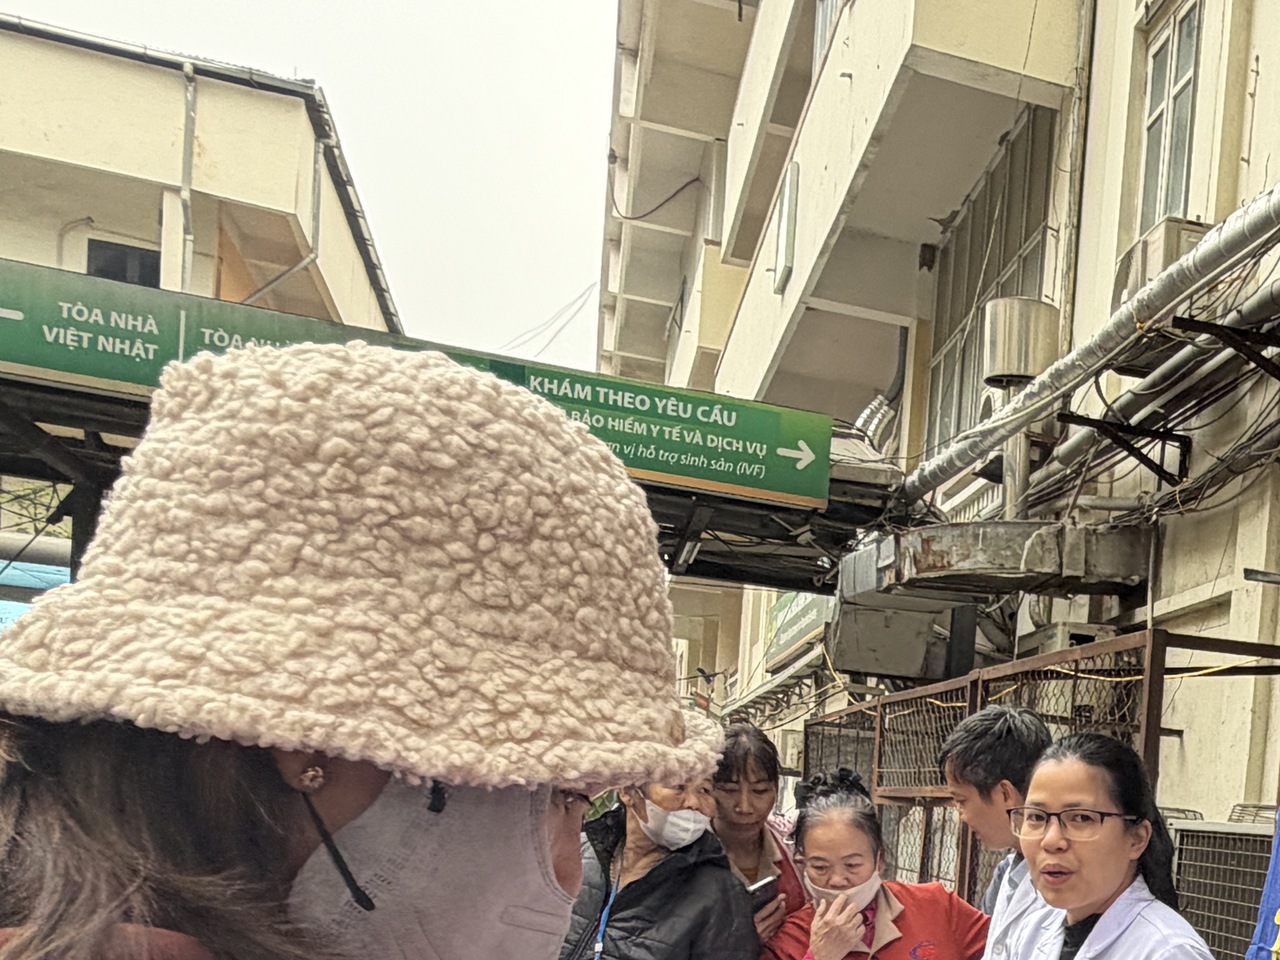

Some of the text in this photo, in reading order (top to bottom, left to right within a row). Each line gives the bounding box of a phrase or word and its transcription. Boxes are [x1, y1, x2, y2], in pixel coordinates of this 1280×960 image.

[58, 301, 159, 335] TÒA NHÀ
[42, 325, 159, 362] VIỆT NHẬT
[201, 327, 242, 349] TÒA
[529, 375, 591, 401] KHÁM
[596, 387, 650, 410] THEO
[655, 397, 692, 418] YÊU
[571, 409, 604, 428] BẢO
[650, 424, 660, 437] Y
[663, 426, 681, 441] TẾ
[683, 429, 703, 446] VÀ
[707, 434, 743, 452] DỊCH
[746, 441, 767, 459] VỤ
[623, 442, 636, 458] vị
[659, 449, 679, 465] trợ
[680, 453, 708, 467] sinh
[710, 457, 733, 472] sản
[736, 461, 766, 479] (IVF)
